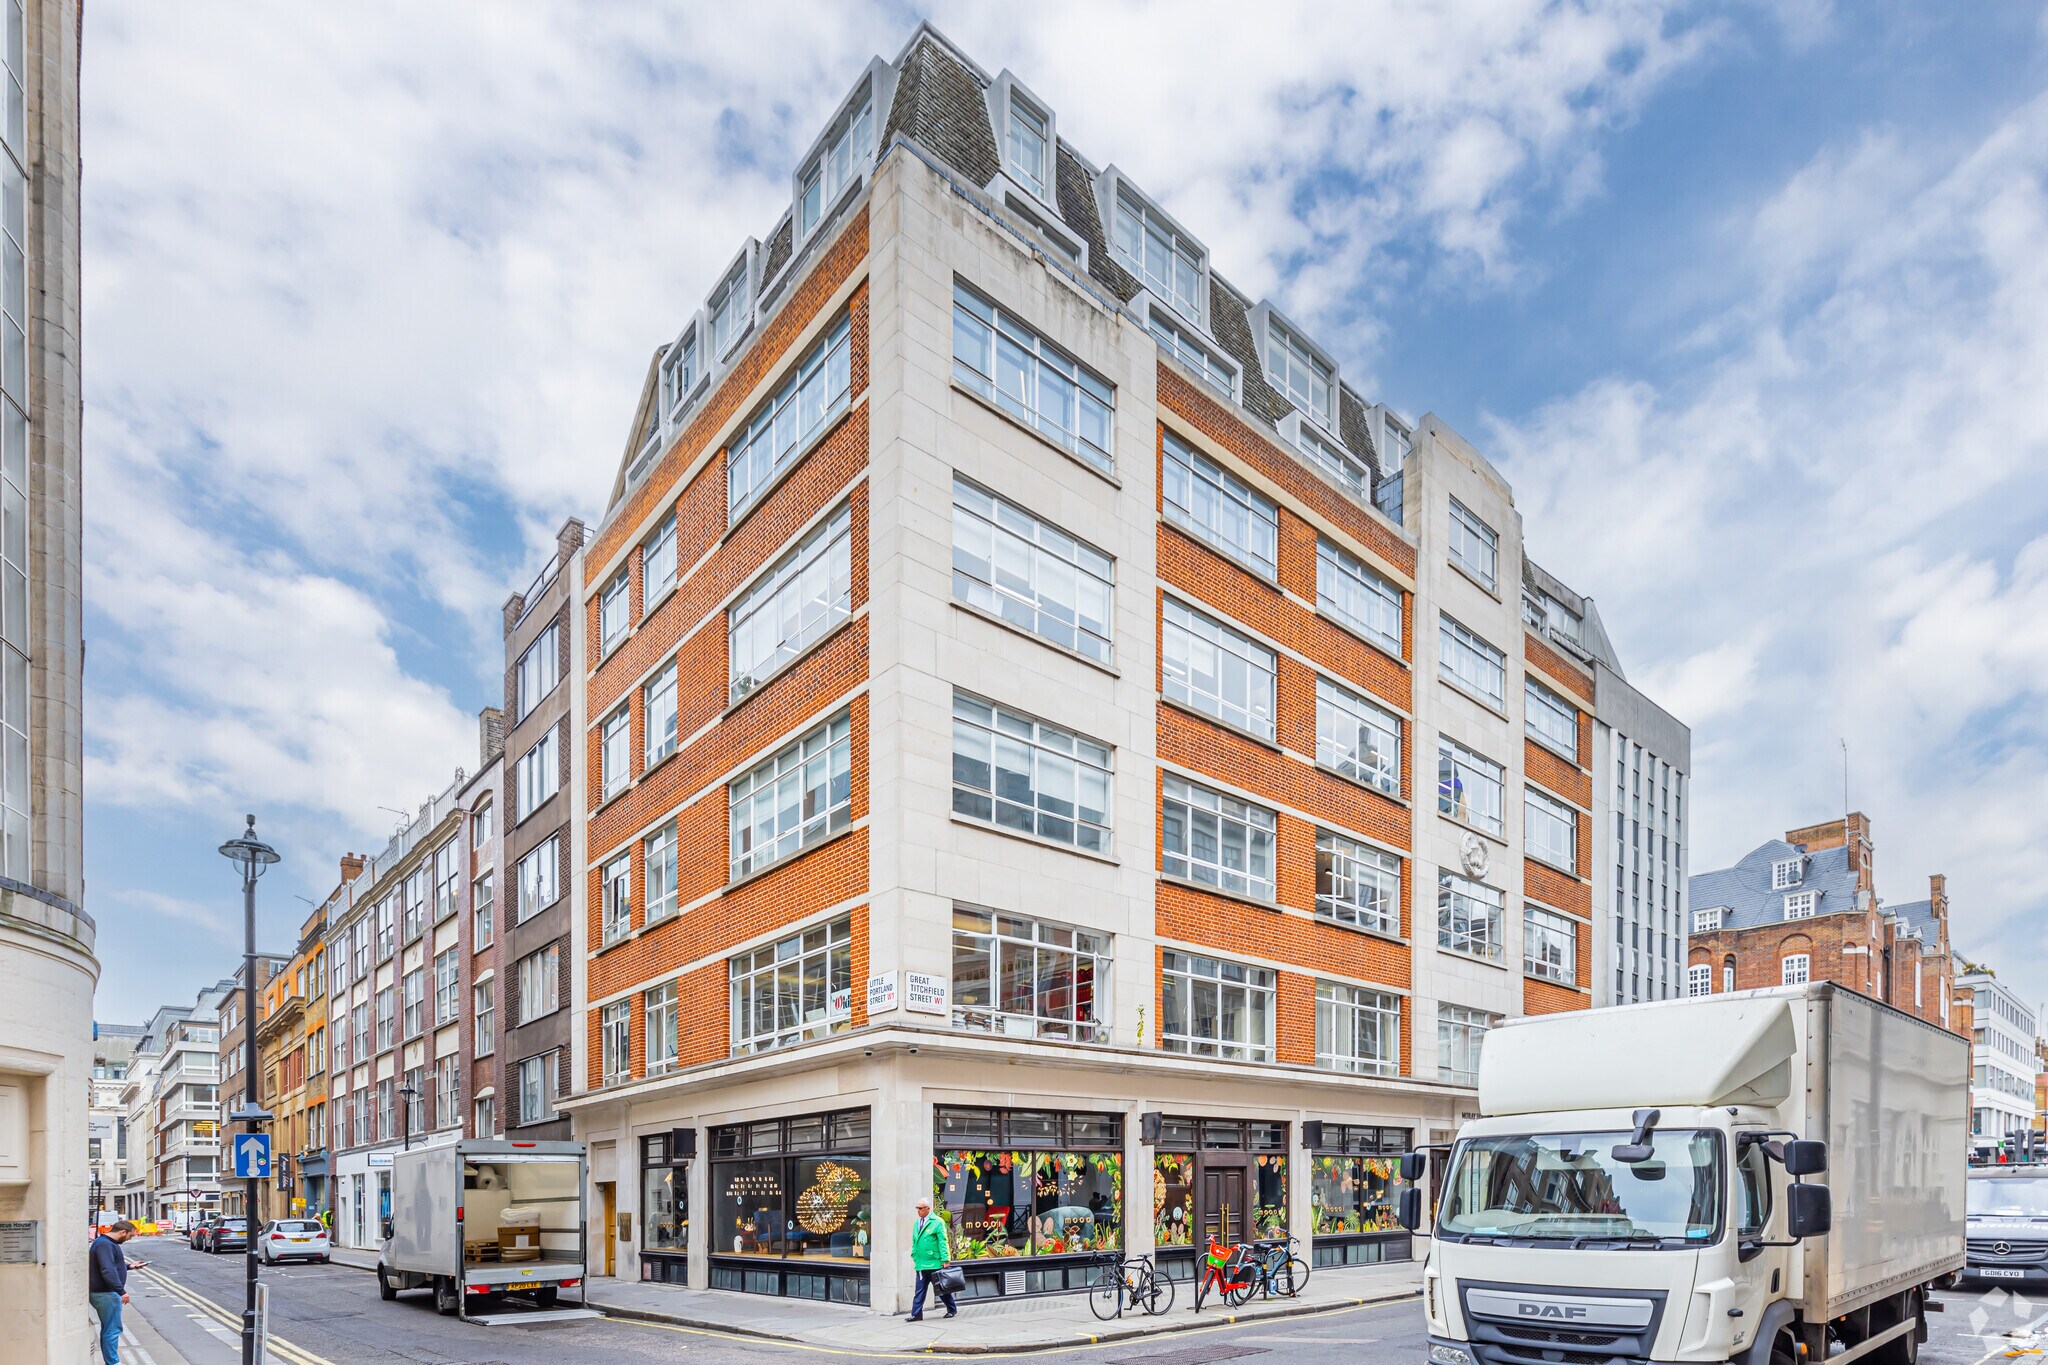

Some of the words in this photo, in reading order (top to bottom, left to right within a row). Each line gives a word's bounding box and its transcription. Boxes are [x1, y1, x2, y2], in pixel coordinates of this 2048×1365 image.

[870, 976, 884, 988] LITTLE
[910, 974, 930, 985] GREAT
[870, 984, 893, 996] PORTLAND
[910, 984, 944, 997] TITCHFIELD
[870, 995, 886, 1006] STREET
[887, 992, 895, 1000] W1
[910, 993, 932, 1003] STREET
[934, 996, 943, 1005] W1
[1518, 1304, 1586, 1318] DAF
